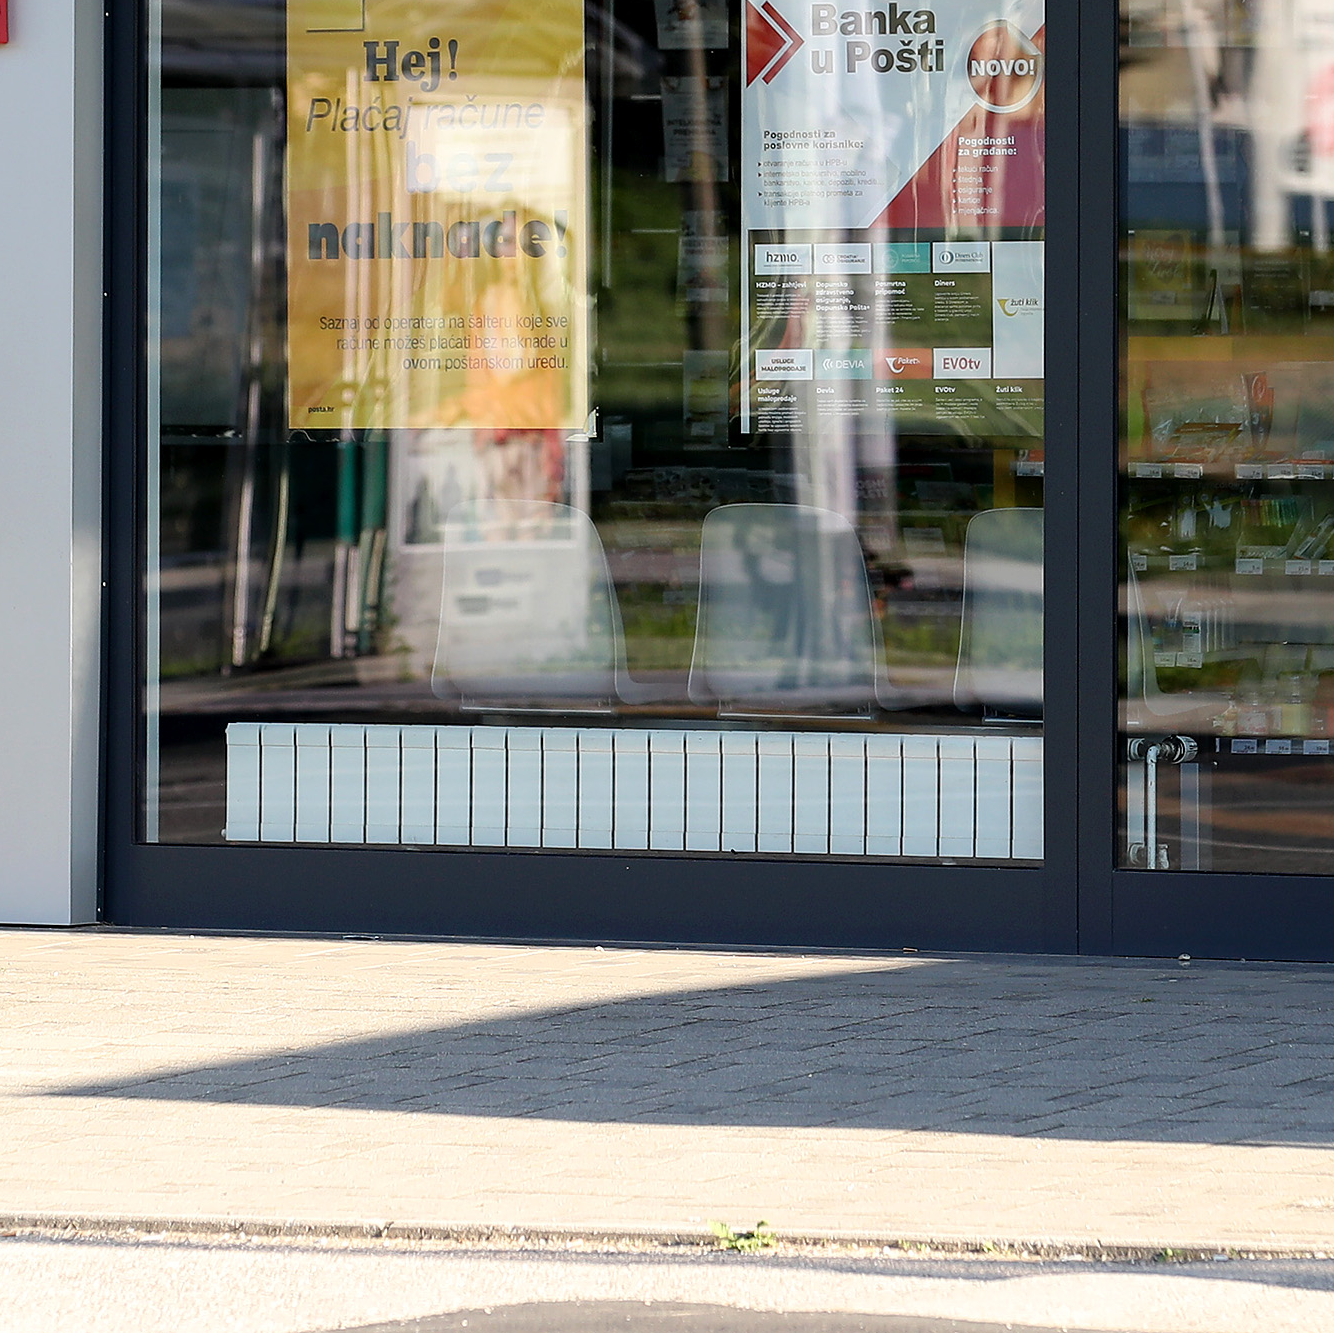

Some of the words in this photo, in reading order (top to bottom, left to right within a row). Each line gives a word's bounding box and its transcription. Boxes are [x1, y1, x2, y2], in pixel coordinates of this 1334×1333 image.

[811, 2, 937, 37] Banka
[811, 49, 835, 75] u
[846, 39, 945, 74] Pošti
[363, 36, 459, 92] Hej!
[970, 58, 1035, 78] NOVO!
[306, 96, 415, 140] Plaćaj
[422, 93, 546, 130] račune
[764, 130, 821, 141] Pogodnosti
[958, 136, 1015, 146] Pogodnosti
[764, 141, 809, 151] poslovne
[813, 140, 864, 149] korisnike:
[958, 148, 969, 156] za
[973, 147, 1017, 157] građane:
[406, 140, 515, 195] bez
[958, 187, 993, 195] osiguranje
[307, 210, 569, 260] naknade!
[782, 281, 807, 289] zahtjevi
[816, 281, 848, 289] Dopunsko
[875, 288, 906, 296] pripomoć
[319, 315, 360, 333] Saznaj
[364, 315, 380, 331] od
[383, 316, 446, 334] operatera
[448, 318, 464, 329] na
[468, 314, 513, 330] šalteru
[516, 315, 543, 333] koje
[546, 317, 568, 328] sve
[336, 335, 380, 351] račune
[383, 335, 426, 350] možeš
[429, 334, 471, 354] plaćati
[475, 334, 497, 350] bez
[501, 333, 557, 349] naknade
[560, 337, 568, 349] u
[403, 357, 441, 370] ovom
[444, 353, 524, 373] poštanskom
[527, 354, 569, 370] uredu.
[835, 360, 865, 369] DEVIA
[943, 357, 981, 370] EVOtv
[758, 395, 797, 403] maloprodaje
[308, 404, 335, 414] posta.hr
